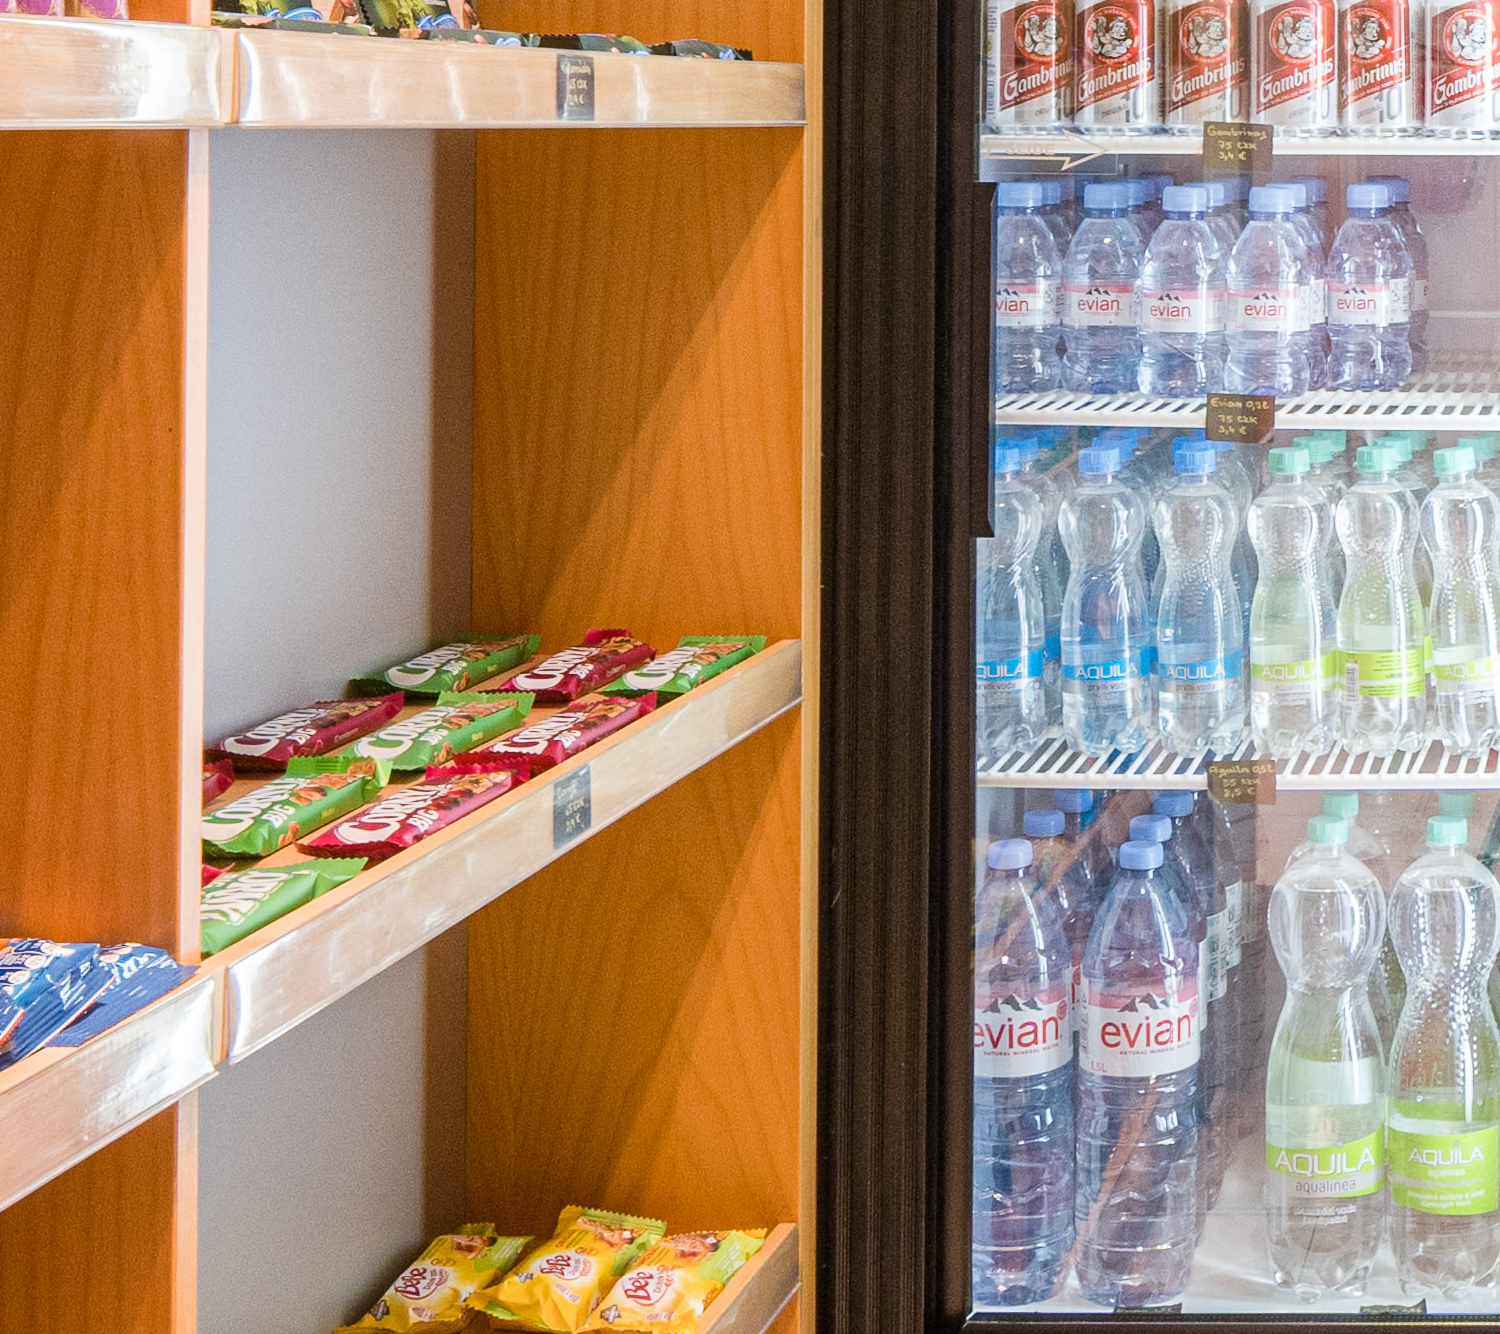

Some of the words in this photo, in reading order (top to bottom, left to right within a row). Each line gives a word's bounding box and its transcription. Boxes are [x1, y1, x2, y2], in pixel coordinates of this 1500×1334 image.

[1078, 57, 1151, 102] Gambrinus
[1172, 57, 1245, 103] Gambrinus
[1260, 57, 1334, 105] Gambrinus
[1078, 298, 1121, 313] evian
[1150, 304, 1192, 319] evian
[1245, 303, 1288, 318] evian
[411, 807, 439, 830] BIG
[1100, 1012, 1195, 1050] evian
[1275, 1146, 1376, 1176] AQUILA
[1295, 1179, 1357, 1195] aqualinea
